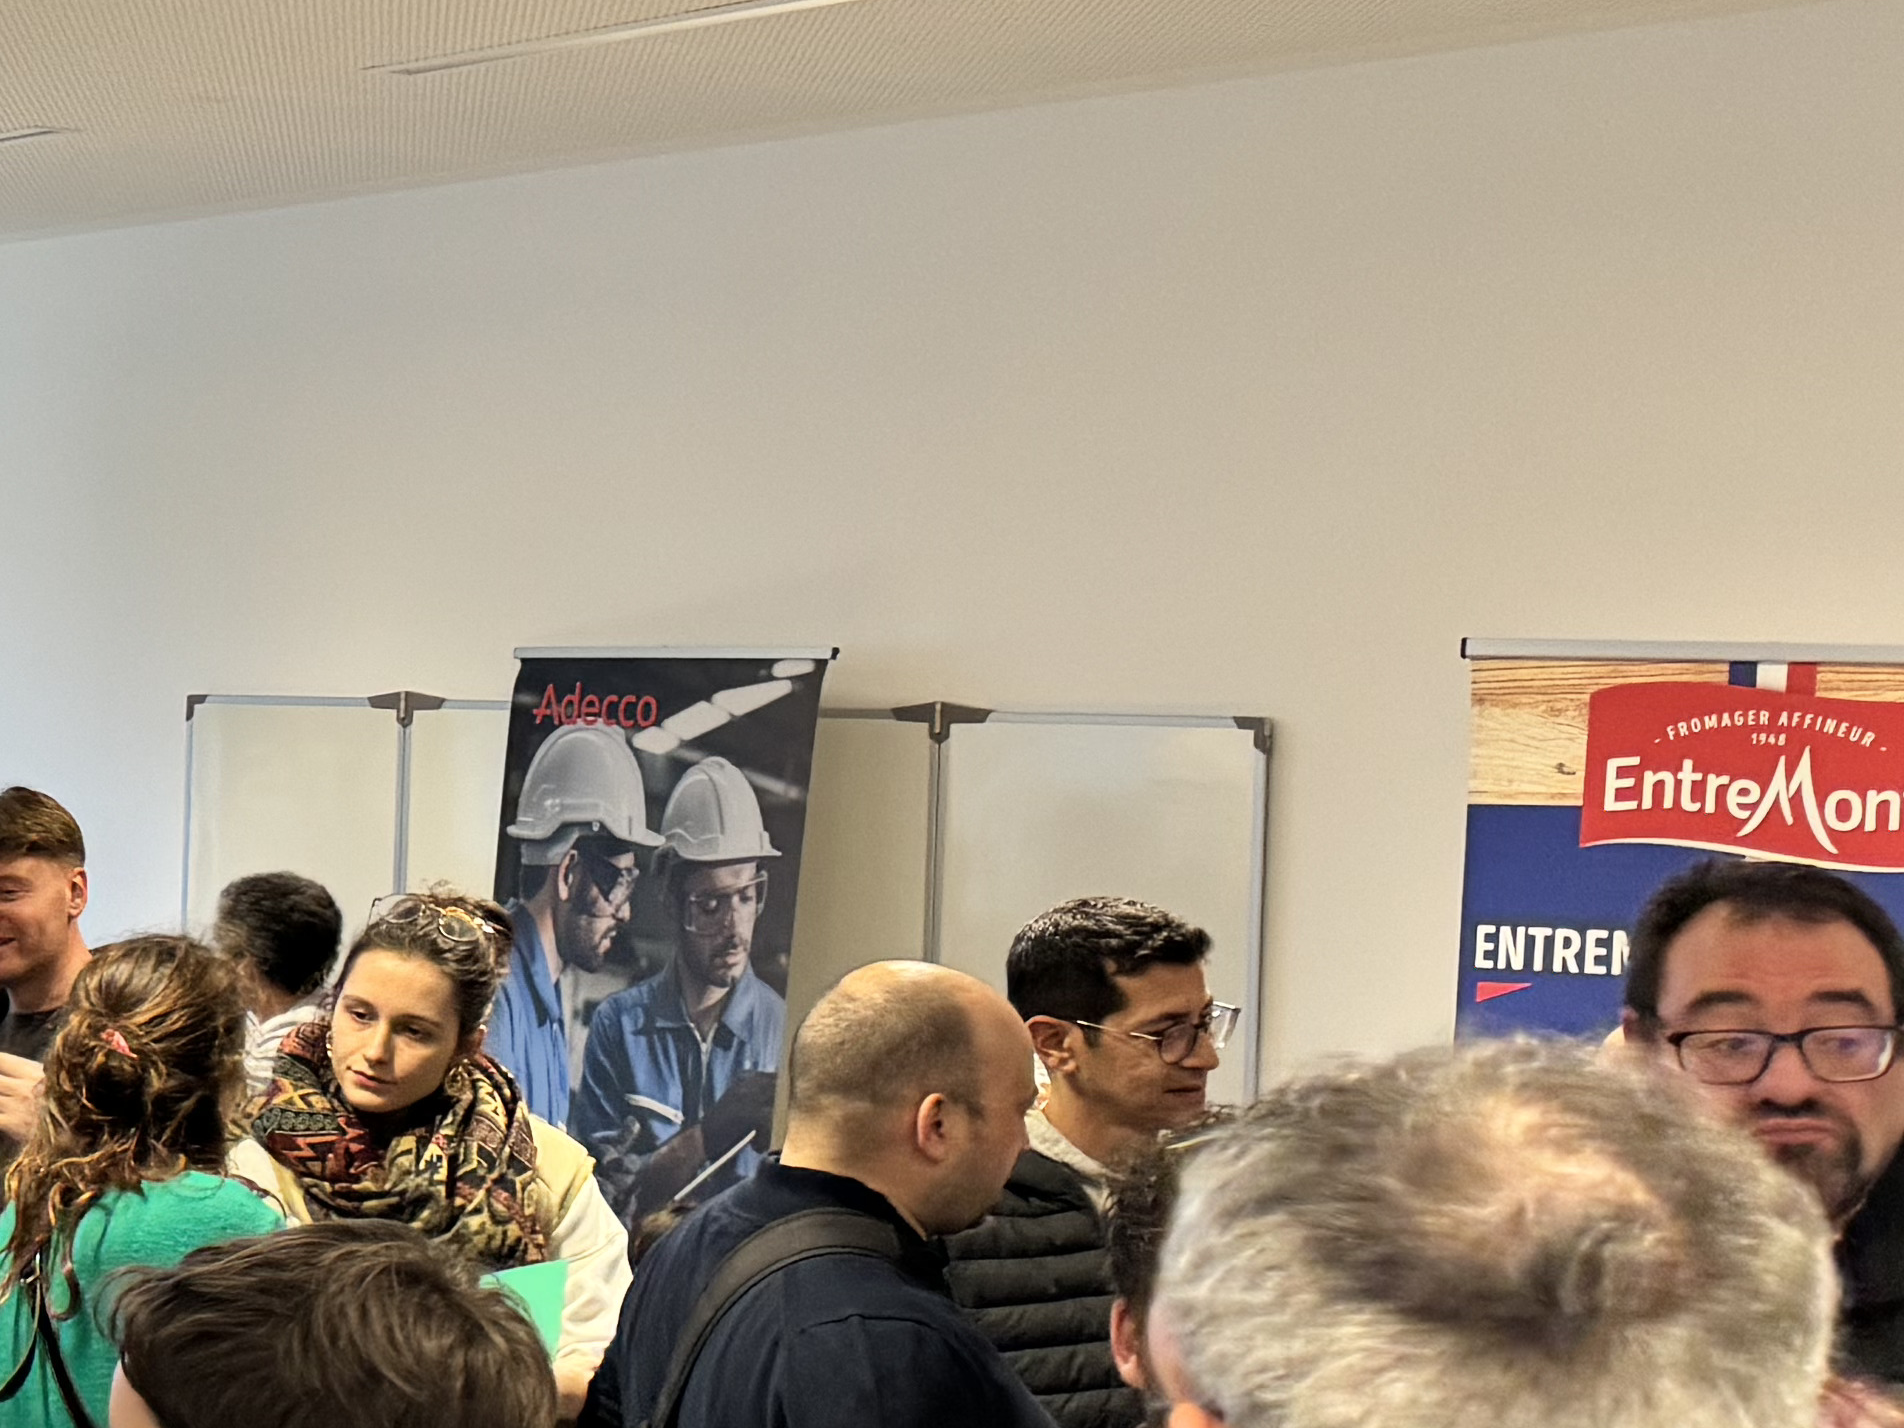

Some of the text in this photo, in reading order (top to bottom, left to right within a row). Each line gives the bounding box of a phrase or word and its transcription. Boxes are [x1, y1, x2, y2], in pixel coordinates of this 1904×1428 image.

[533, 681, 658, 728] Adecco
[1666, 709, 1876, 748] FROMAGER AFFINEUR
[1603, 745, 1904, 855] EntreMon
[1474, 924, 1630, 976] ENTREM
